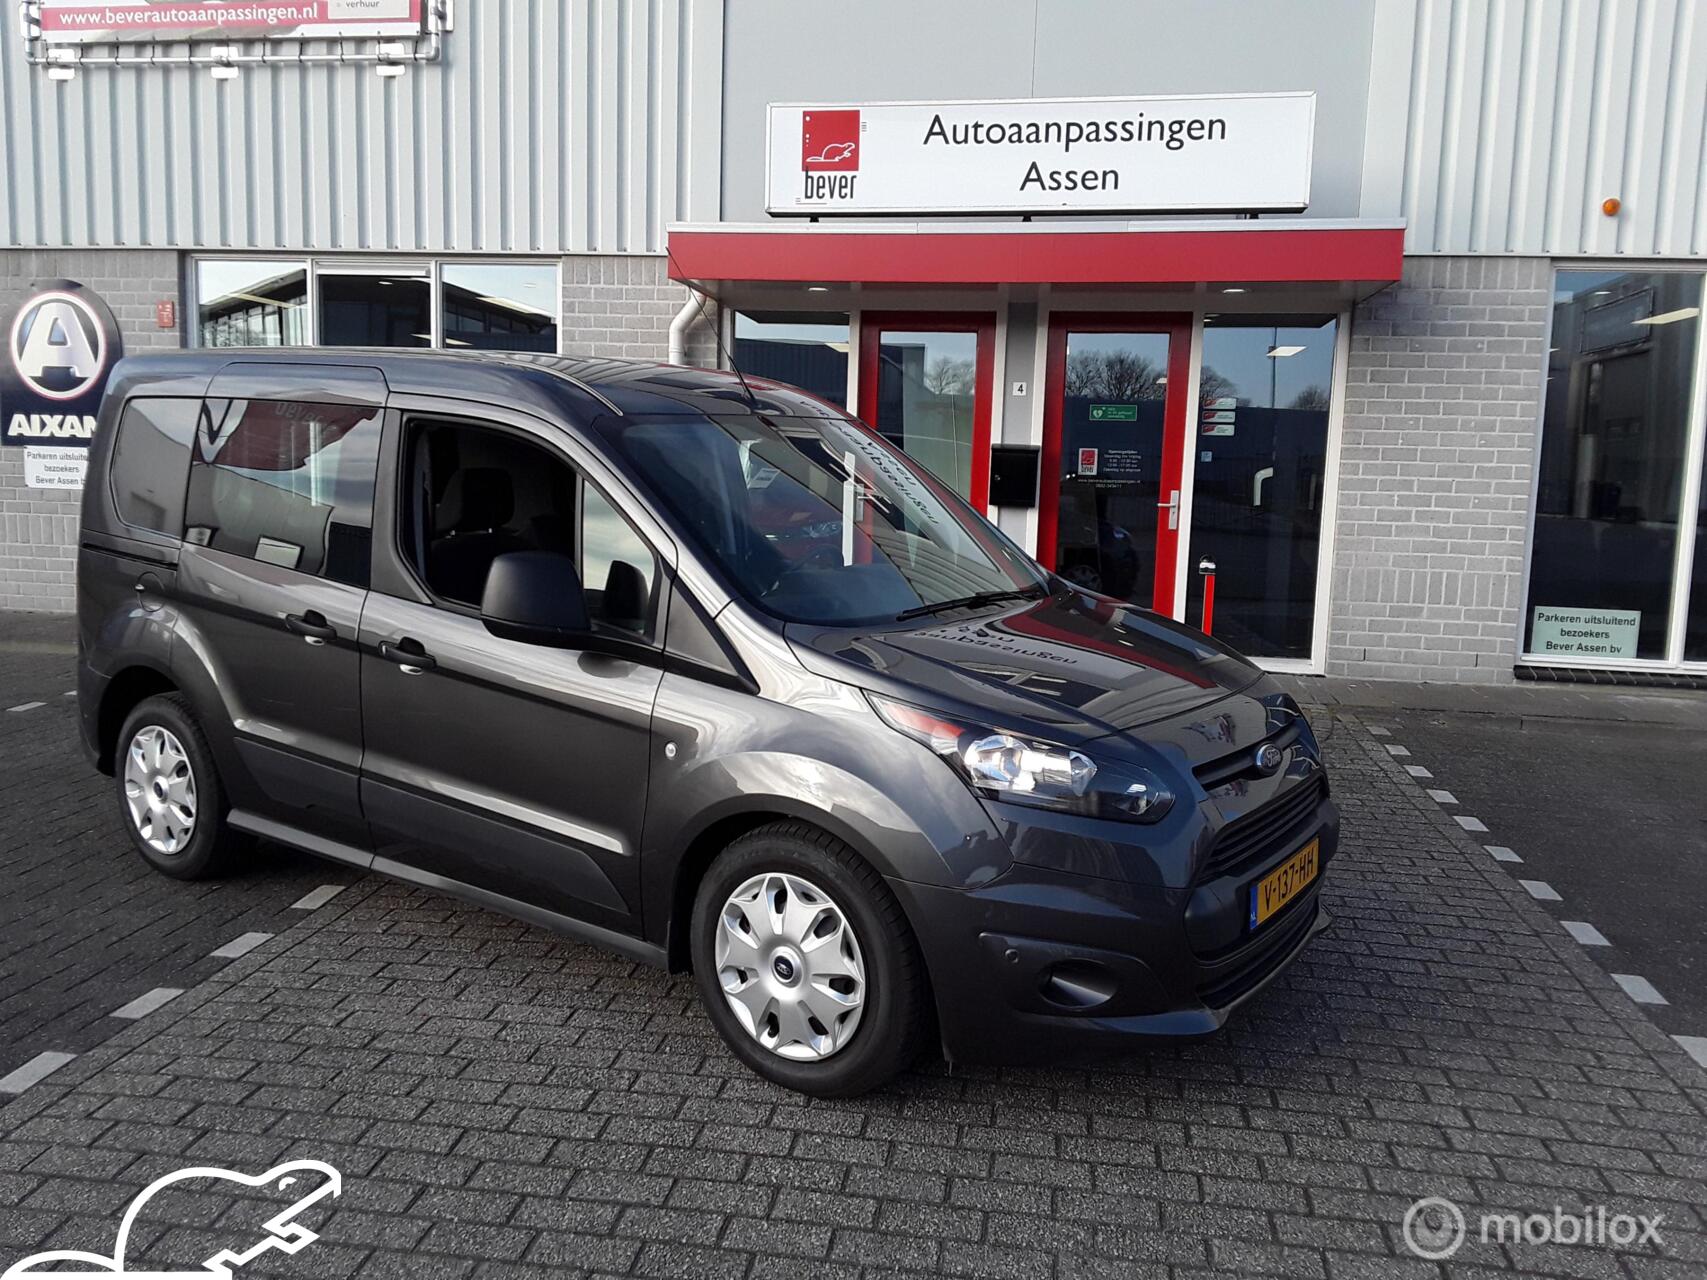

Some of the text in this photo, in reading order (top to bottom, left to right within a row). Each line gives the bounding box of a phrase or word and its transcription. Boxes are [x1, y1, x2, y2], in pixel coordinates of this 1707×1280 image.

[59, 3, 318, 26] www.beverautoaanpassingen.nl
[923, 112, 1227, 152] Autoaanpassingen
[804, 165, 857, 200] bever
[1019, 161, 1120, 192] Assen
[1016, 384, 1025, 394] 4
[27, 451, 57, 461] Parkeren
[44, 465, 80, 473] bezoekers
[35, 475, 56, 485] Bever
[57, 476, 79, 486] Assen
[1537, 612, 1636, 627] Parkeren uitsluitend
[1560, 627, 1610, 639] bezoekers
[1545, 640, 1622, 654] Bever Assen bv
[1264, 847, 1314, 912] V-137-HH
